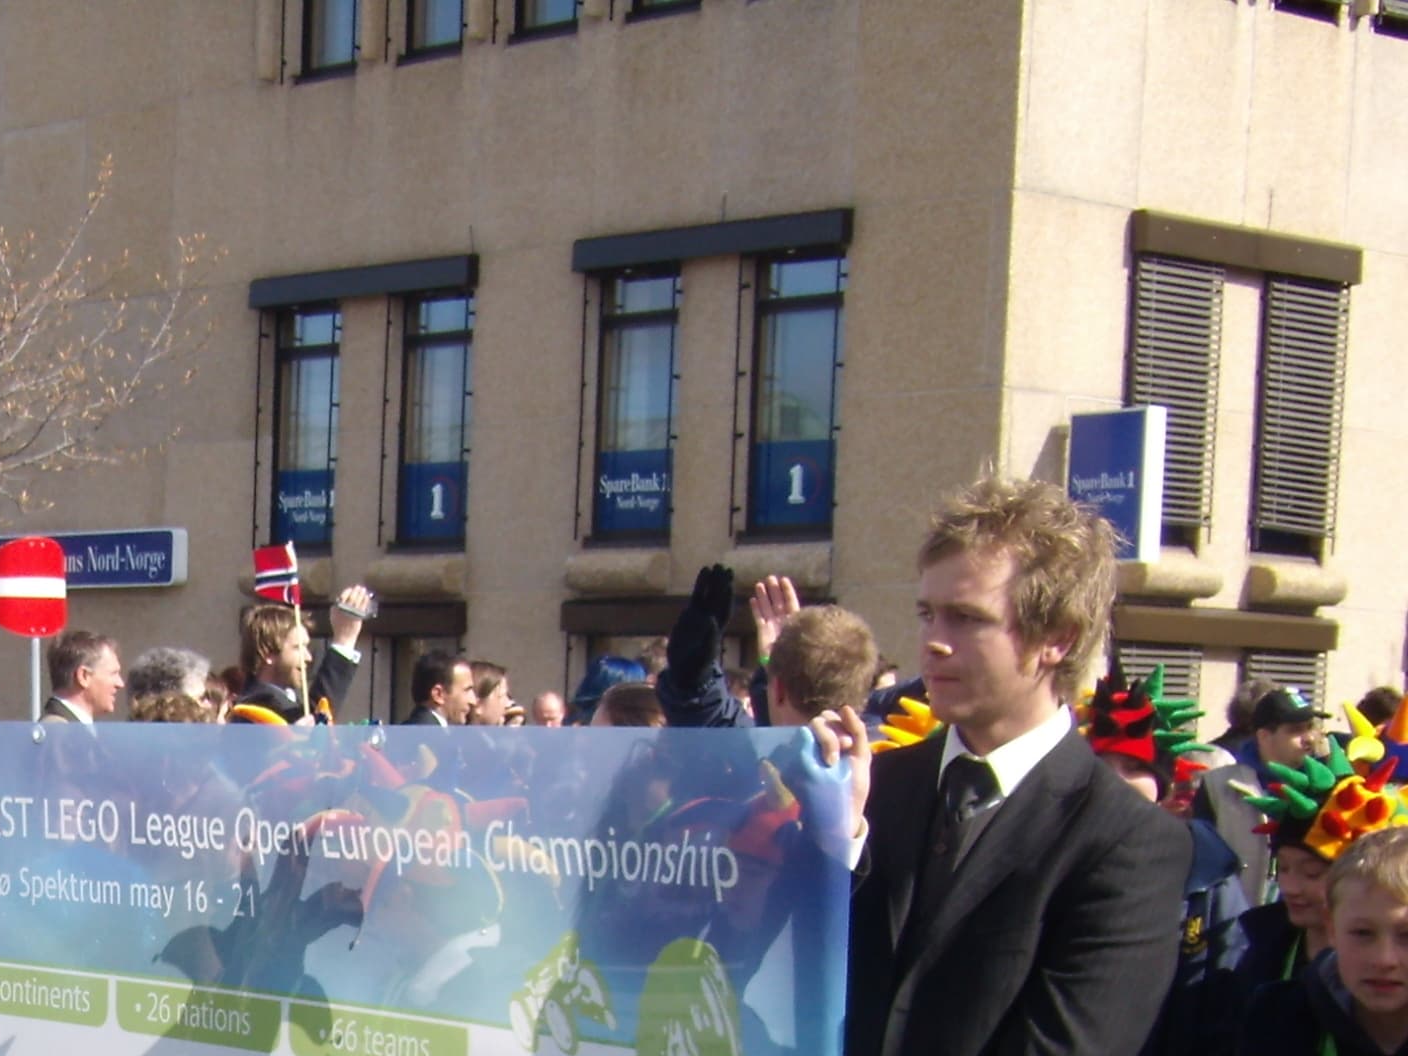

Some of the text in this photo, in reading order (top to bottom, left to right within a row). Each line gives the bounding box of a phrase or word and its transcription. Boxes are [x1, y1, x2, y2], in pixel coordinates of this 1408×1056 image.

[599, 472, 660, 498] SpareBank
[788, 464, 805, 504] 1
[1128, 471, 1135, 488] 1
[430, 484, 444, 519] 1
[88, 545, 165, 578] Nord-Norge
[43, 799, 119, 843] LEGO
[130, 802, 226, 859] League
[235, 807, 310, 866] Open
[320, 817, 471, 876] European
[484, 820, 738, 902] Championship
[19, 868, 121, 905] Spektrum
[129, 884, 174, 918] may
[185, 881, 208, 914] 16
[232, 884, 255, 917] 21
[147, 993, 252, 1035] 26 nations
[331, 1018, 357, 1051] 66
